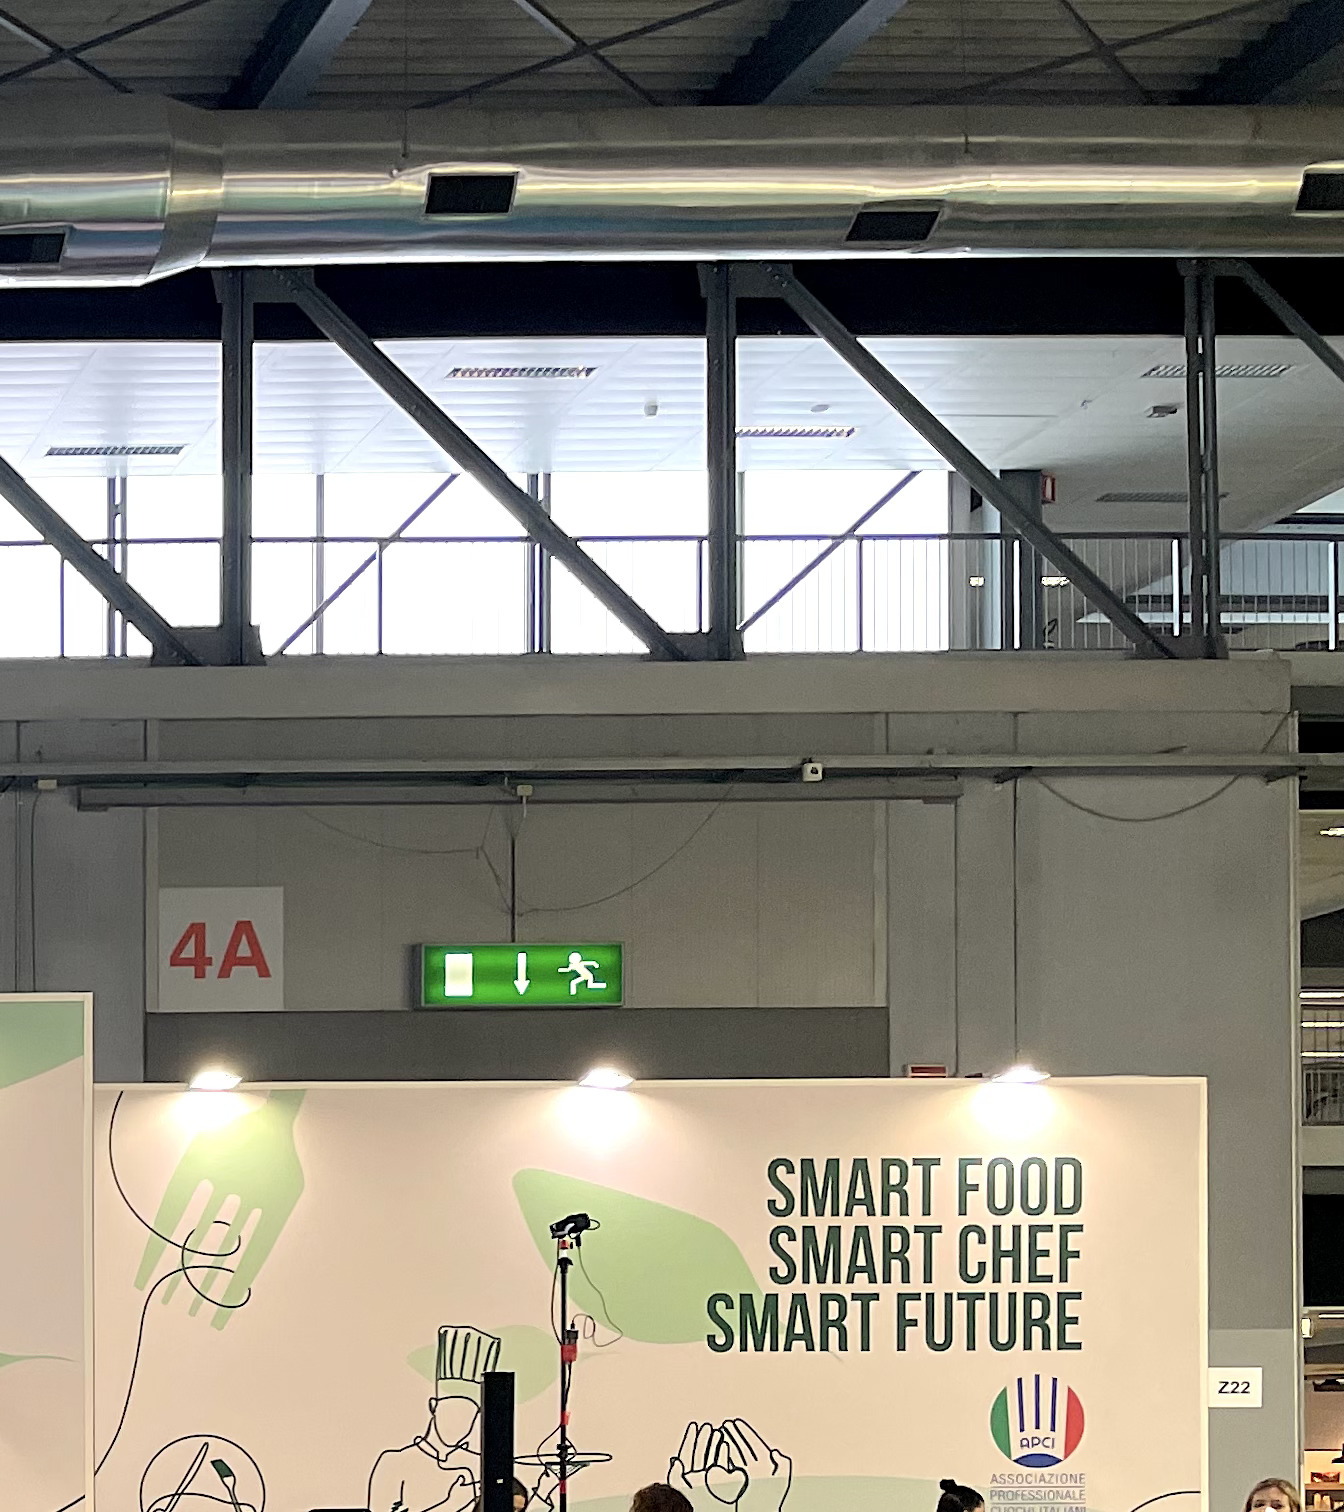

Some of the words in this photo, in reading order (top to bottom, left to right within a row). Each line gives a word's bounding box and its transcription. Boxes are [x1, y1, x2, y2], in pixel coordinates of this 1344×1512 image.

[169, 919, 271, 980] 4A
[767, 1157, 941, 1218] SMART
[957, 1157, 1084, 1217] FOOD
[768, 1224, 943, 1285] SMART
[957, 1224, 1084, 1285] CHEF
[705, 1292, 880, 1353] SMART
[896, 1292, 1084, 1352] FUTURE
[1217, 1380, 1251, 1395] Z22
[1019, 1436, 1056, 1449] APCI
[989, 1472, 1086, 1485] ASSOCIAZIONE
[989, 1489, 1087, 1501] PROFESSIONALE
